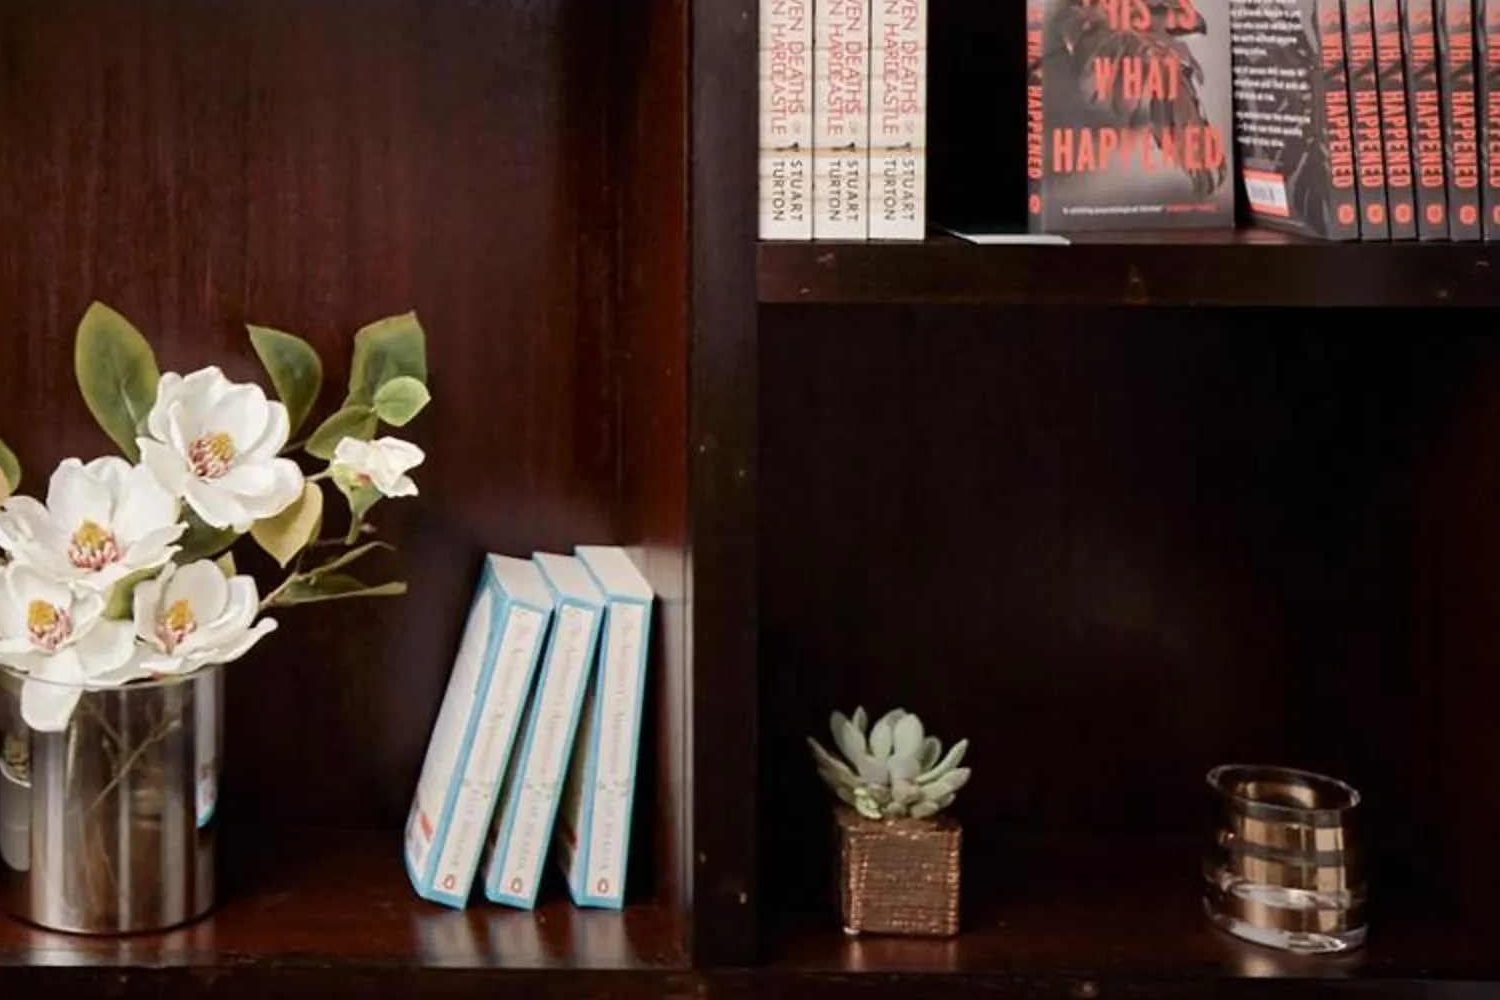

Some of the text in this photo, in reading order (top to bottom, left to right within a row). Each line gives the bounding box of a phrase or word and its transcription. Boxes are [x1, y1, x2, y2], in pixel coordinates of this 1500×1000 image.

[788, 41, 804, 114] DEATHS
[845, 41, 862, 114] DEATHS
[901, 41, 918, 114] DEATHS
[1094, 56, 1181, 103] WHAT
[1053, 125, 1223, 173] HAPPENED
[772, 160, 785, 222] TURTON
[790, 160, 803, 222] STUART
[828, 160, 841, 222] TURTON
[847, 160, 859, 222] STUART
[884, 160, 896, 221] TURTON
[902, 160, 915, 222] STUART
